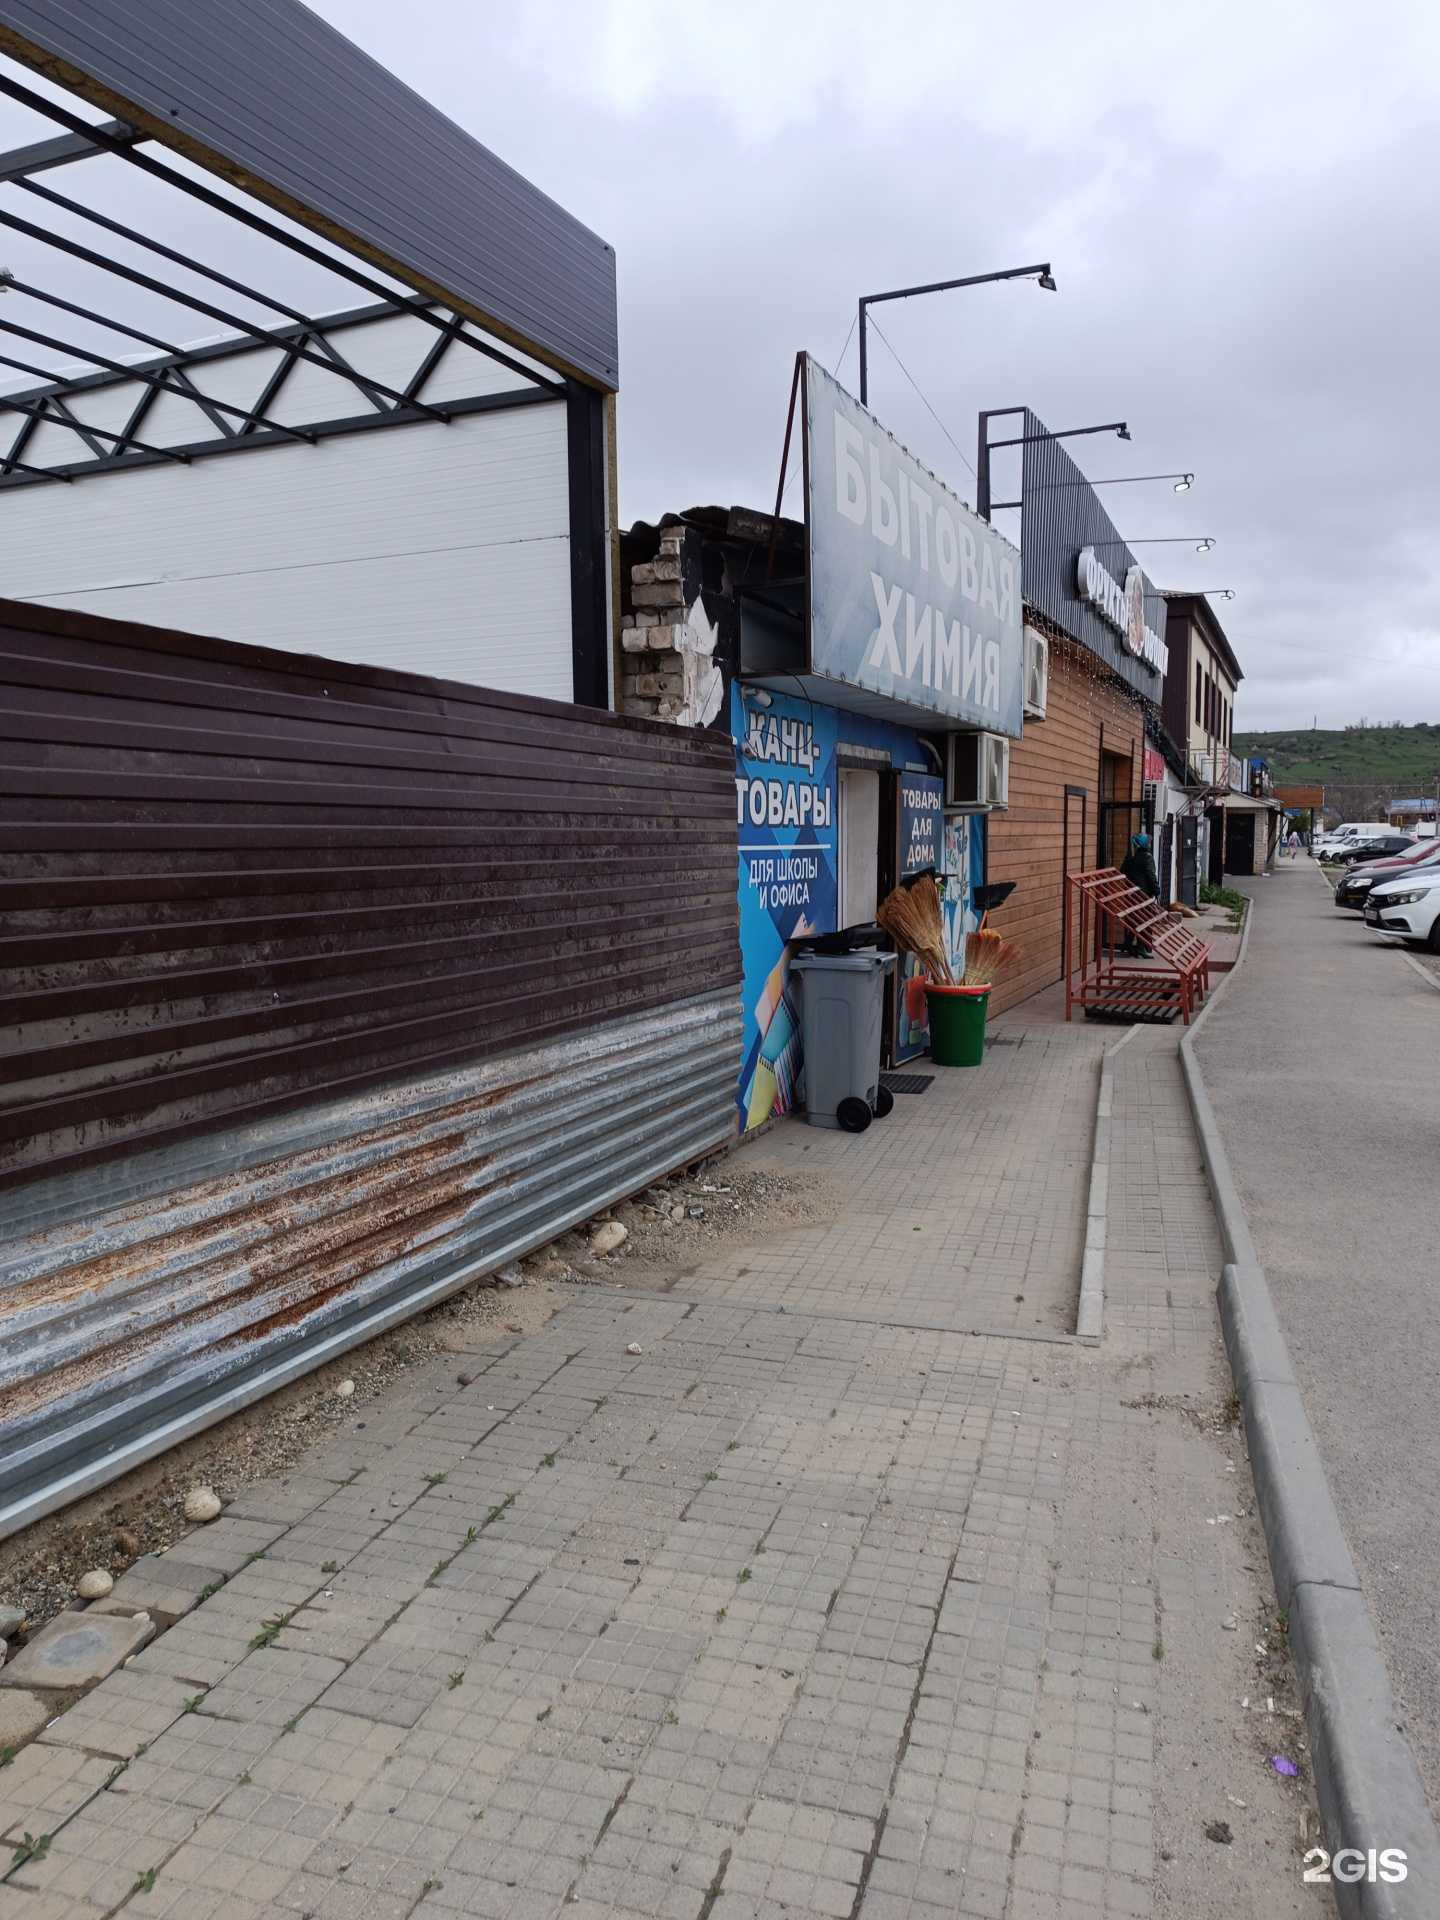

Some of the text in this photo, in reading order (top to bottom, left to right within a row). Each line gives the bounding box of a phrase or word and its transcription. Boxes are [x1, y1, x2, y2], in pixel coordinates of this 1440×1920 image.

[834, 409, 1017, 628] БЫТОВАЯ
[1084, 546, 1129, 635] ФРУКТЫ
[867, 572, 1000, 714] ХИМИЯ
[735, 778, 831, 827] ТОВАРЫ
[902, 788, 942, 811] ТОВАРЫ
[911, 817, 932, 837] ДЛЯ
[906, 844, 935, 867] ДОМА
[749, 857, 818, 889] ДЛЯ ШКОЛЫ
[759, 882, 810, 909] И ОФИСА
